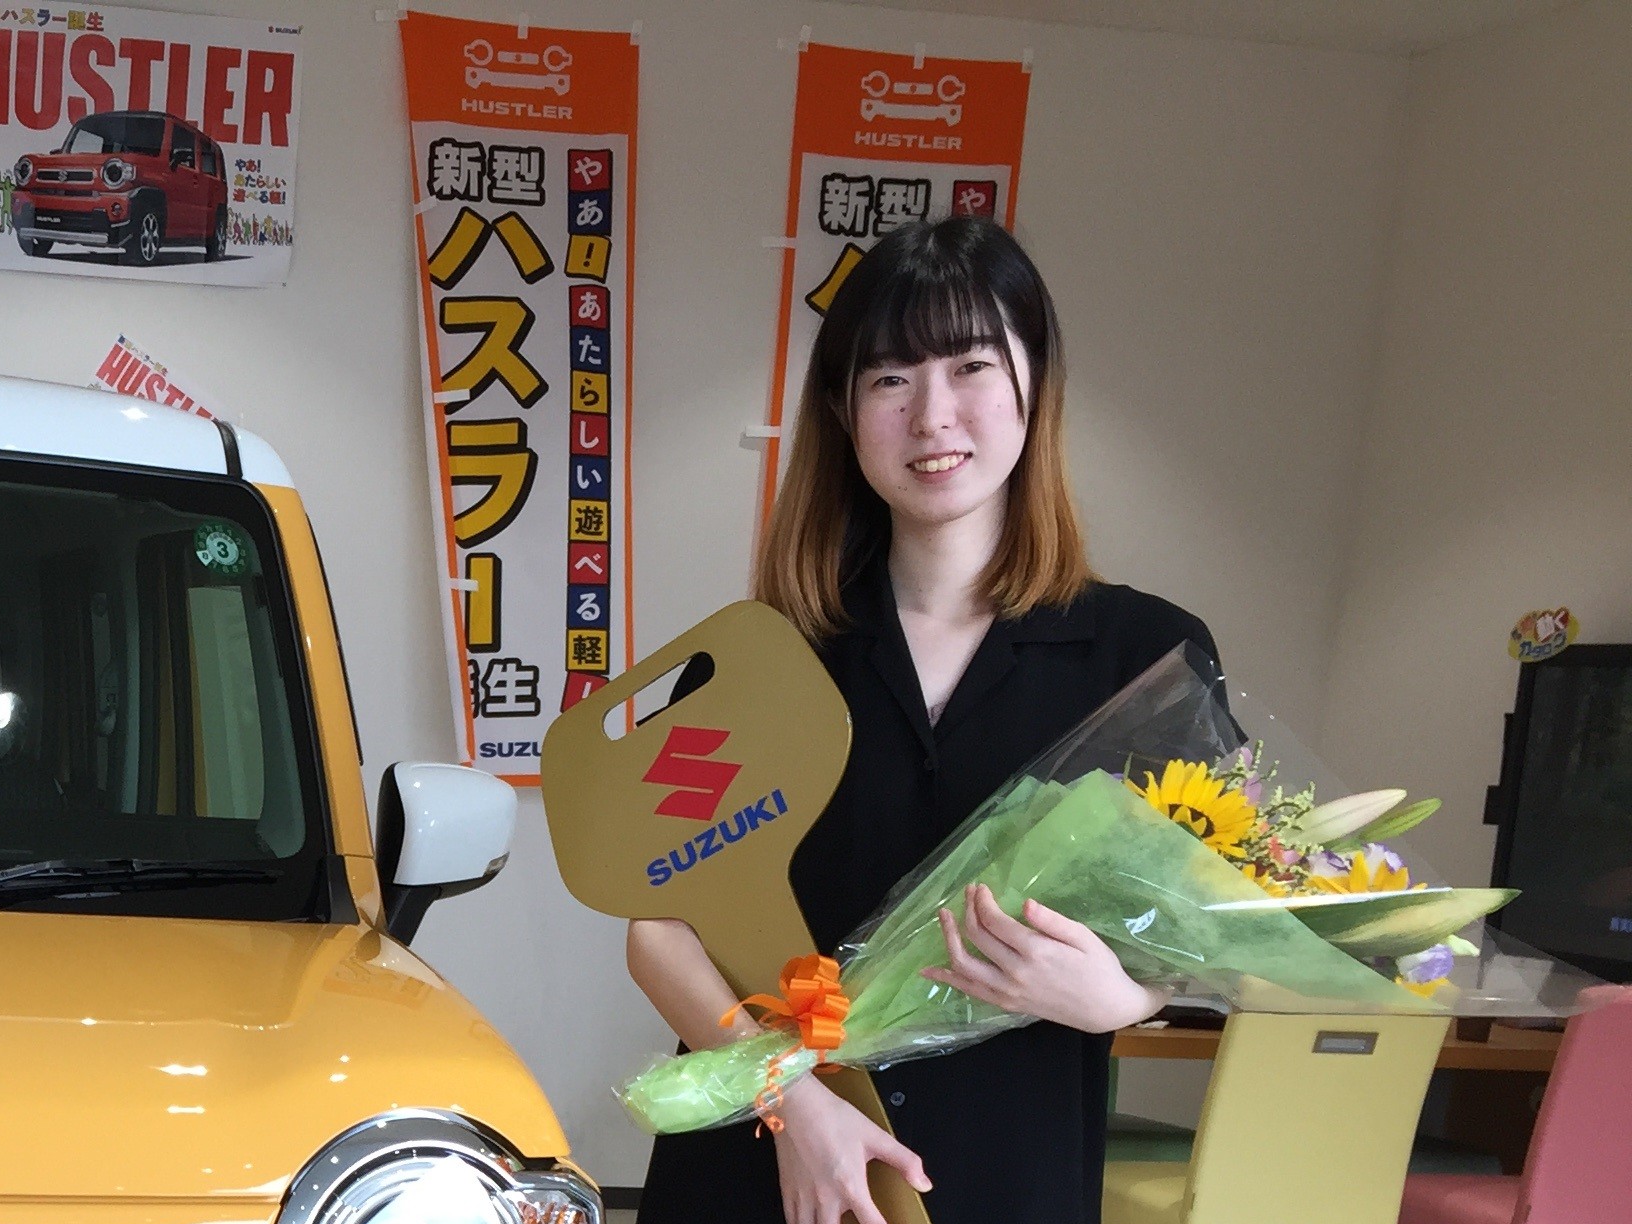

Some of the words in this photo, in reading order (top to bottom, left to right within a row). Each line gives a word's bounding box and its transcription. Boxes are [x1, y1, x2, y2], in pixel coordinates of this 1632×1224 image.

[461, 97, 574, 121] HUSTLER
[853, 130, 964, 151] HUSTLER
[427, 137, 546, 206] 新型
[818, 172, 932, 238] 新型
[427, 205, 555, 653] ハスラー
[216, 541, 230, 559] 3
[466, 657, 541, 719] 生
[646, 788, 789, 887] SUZUKI
